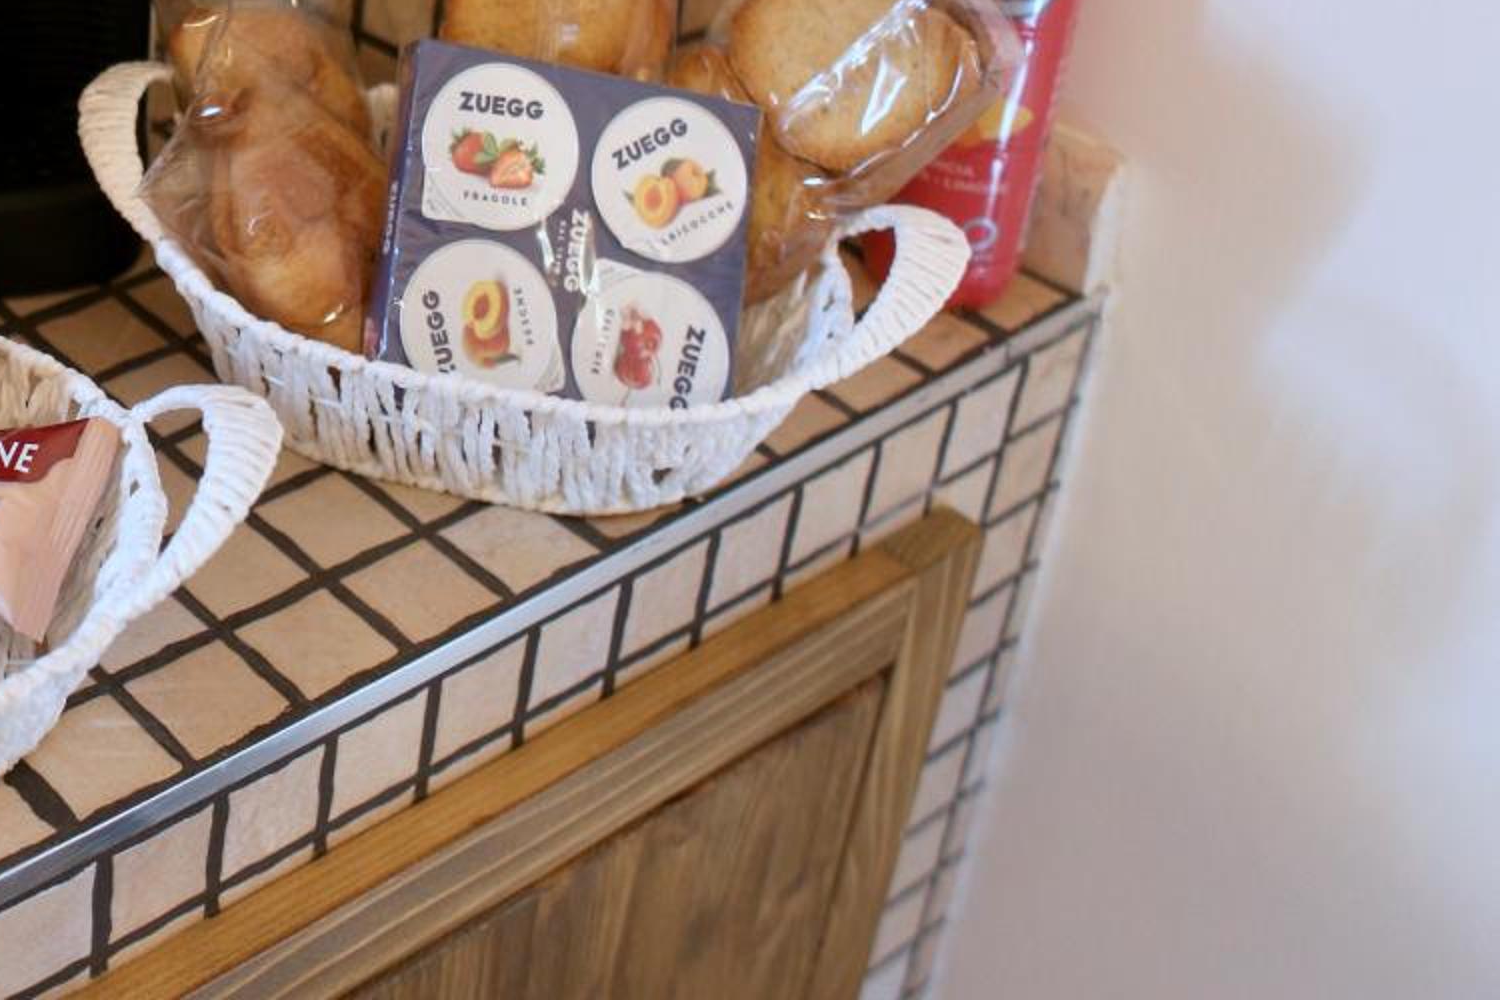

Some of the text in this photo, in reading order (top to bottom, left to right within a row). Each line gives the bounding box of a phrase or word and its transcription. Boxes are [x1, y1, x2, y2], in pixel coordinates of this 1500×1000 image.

[458, 91, 544, 119] ZUEGG
[611, 118, 688, 170] ZUEGG
[668, 325, 706, 411] ZUEGG
